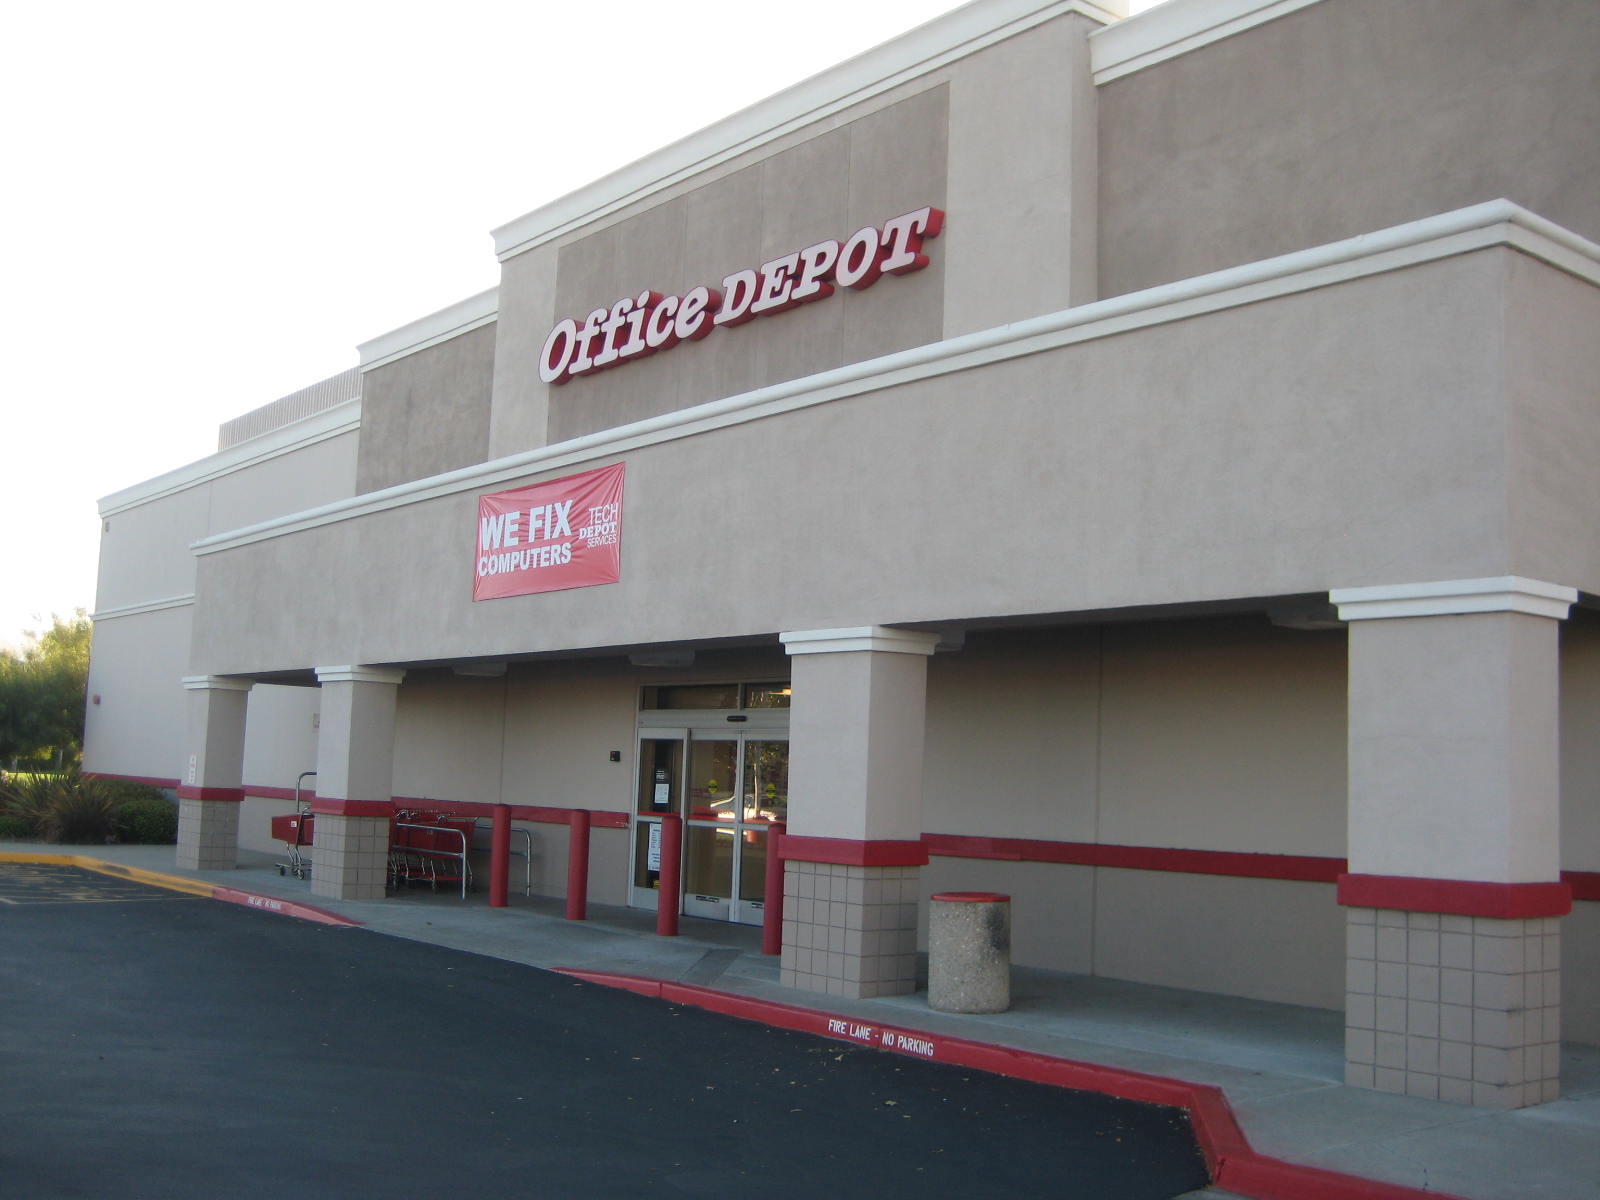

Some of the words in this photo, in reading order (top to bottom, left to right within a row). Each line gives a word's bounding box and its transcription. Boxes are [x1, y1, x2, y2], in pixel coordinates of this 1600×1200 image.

[538, 286, 715, 384] Office
[714, 206, 938, 327] DEPOT
[481, 511, 520, 550] WE
[528, 500, 573, 543] FIX
[578, 521, 617, 540] DEPOT
[588, 502, 619, 525] TECH
[586, 533, 617, 549] SERVICES
[478, 542, 572, 576] COMPUTERS
[828, 1019, 847, 1034] FIRE
[849, 1023, 871, 1040] LANE
[882, 1031, 894, 1046] NO
[897, 1035, 934, 1056] PARKING
